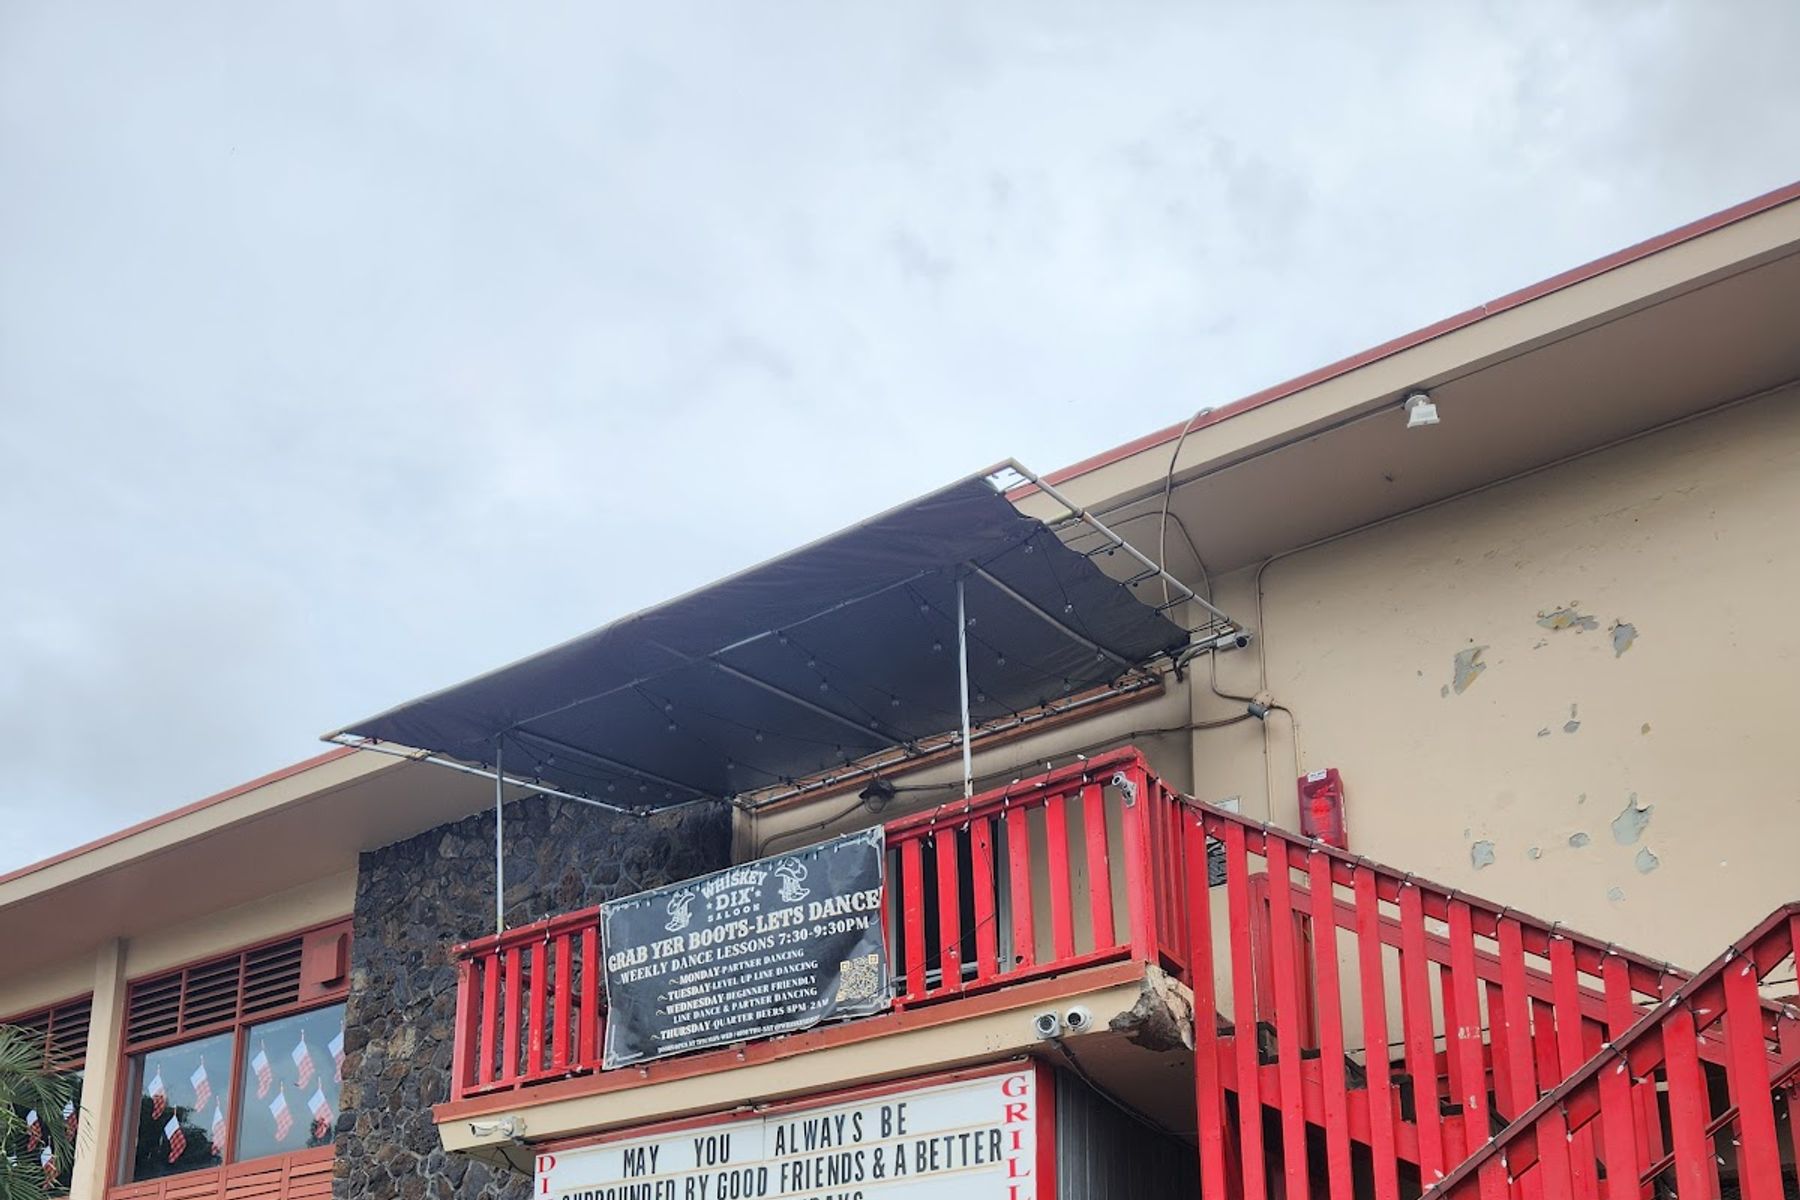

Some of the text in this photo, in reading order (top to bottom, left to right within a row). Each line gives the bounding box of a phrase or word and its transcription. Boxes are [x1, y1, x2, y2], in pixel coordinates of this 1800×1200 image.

[701, 871, 768, 899] WHISKEY
[707, 903, 760, 922] SALOON
[607, 945, 648, 973] GRAB
[651, 935, 685, 960] YER
[620, 915, 870, 985] WEEKLY DANCE LESSONS 7:30-9:30PM
[763, 948, 804, 966] DANCING
[741, 971, 752, 985] UP
[754, 967, 773, 982] LINE
[776, 960, 819, 976] DANCING
[771, 975, 817, 992] FRIENDLY
[673, 987, 818, 1024] LINE DANCE & PARTNER DANCING
[756, 1007, 785, 1021] BEERS
[623, 1102, 907, 1178] MAY YOU ALWAYS BE
[780, 1150, 865, 1193] FRIENDS
[872, 1147, 885, 1179] &
[894, 1144, 907, 1177] A
[916, 1128, 1002, 1173] BETTER
